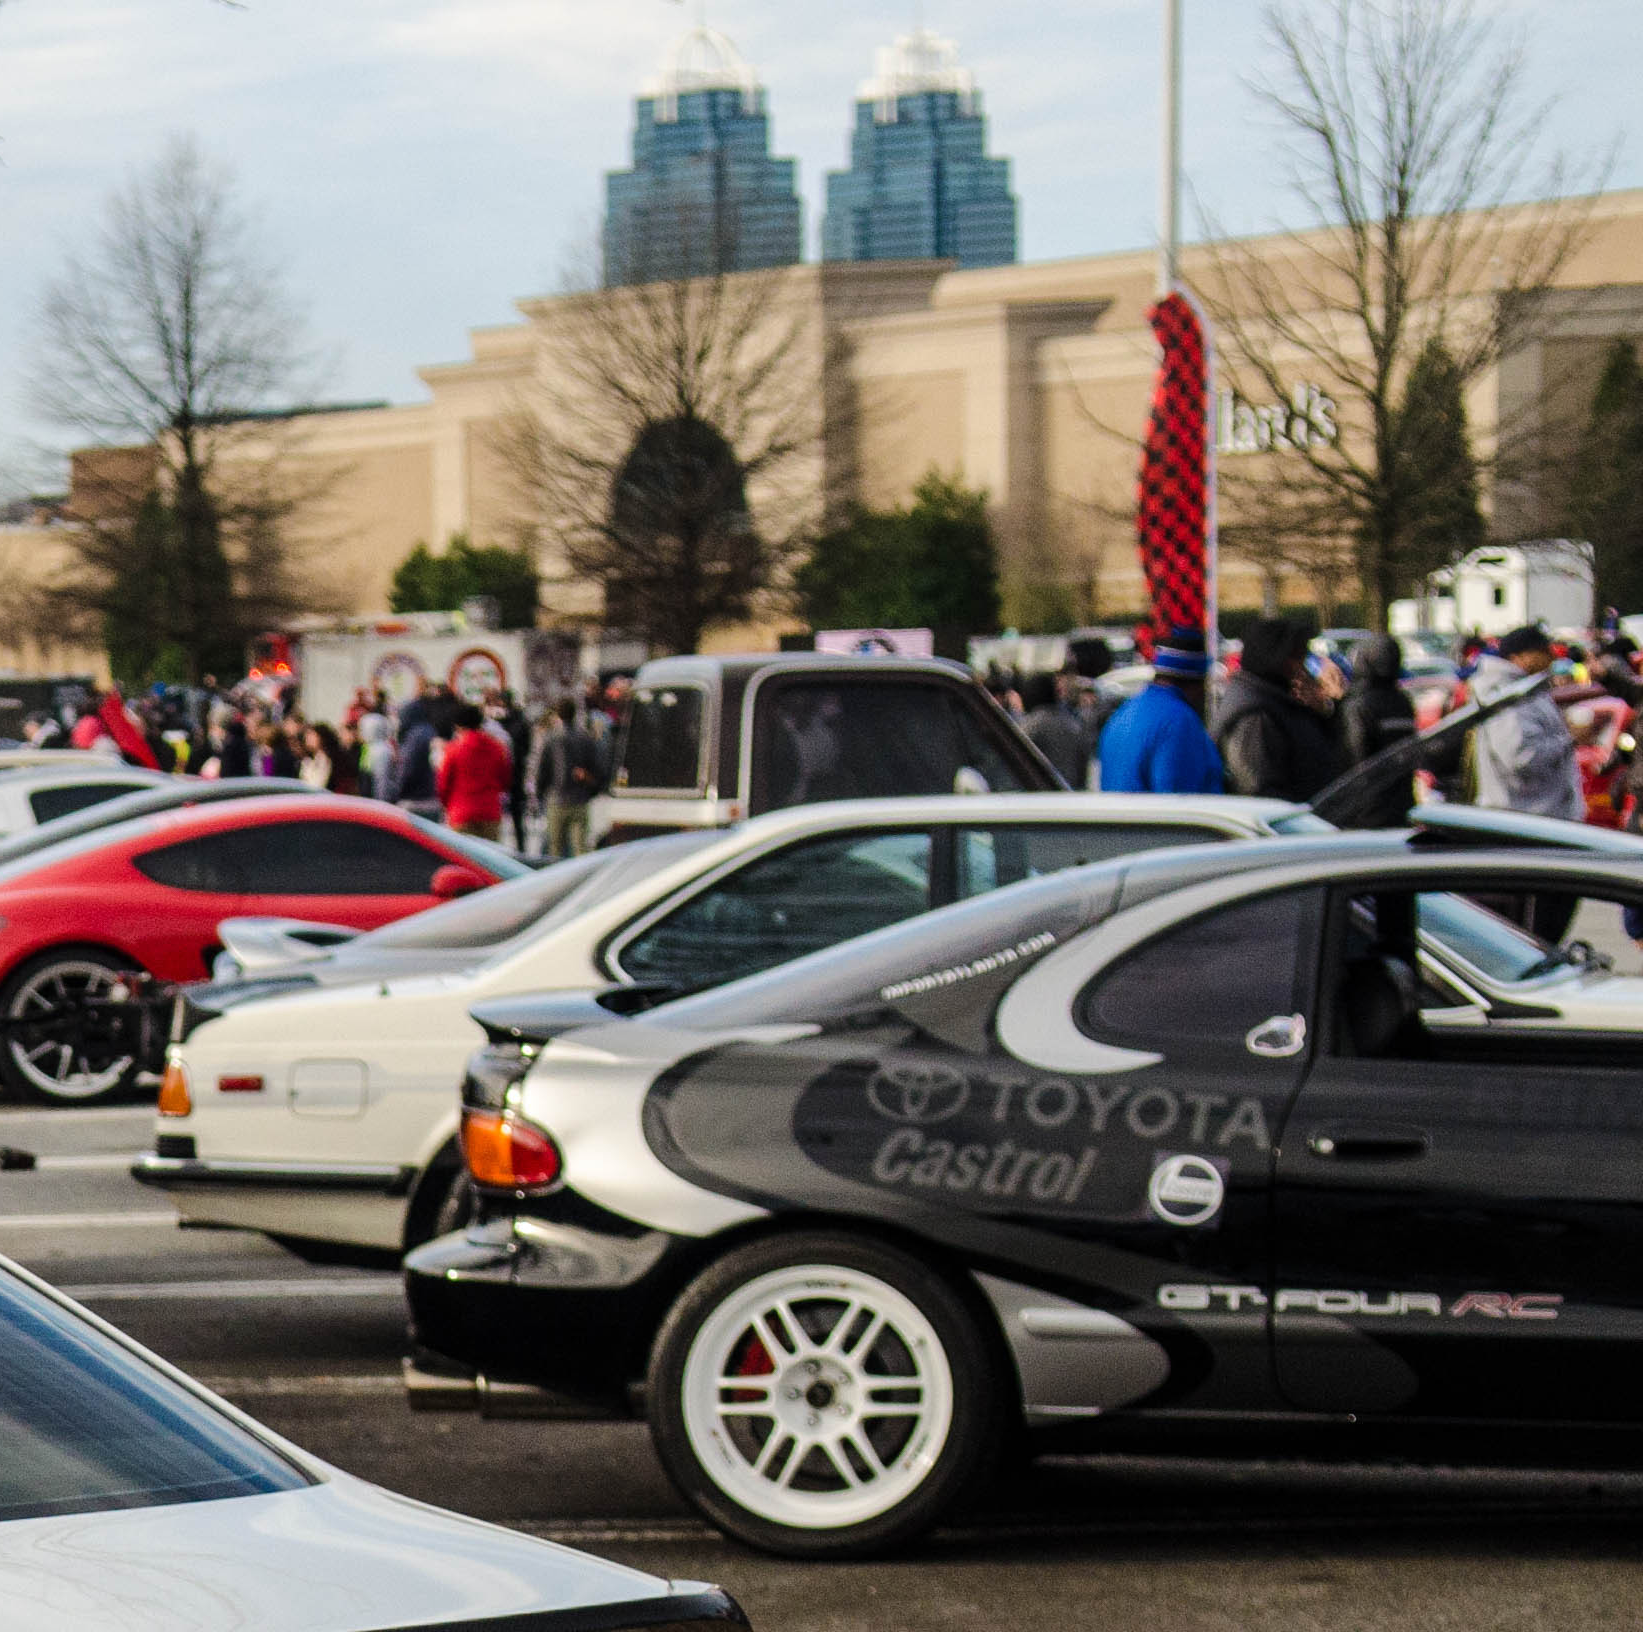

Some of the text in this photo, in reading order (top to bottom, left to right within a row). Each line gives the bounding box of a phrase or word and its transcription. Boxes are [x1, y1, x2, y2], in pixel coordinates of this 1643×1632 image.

[983, 1072, 1272, 1151] TOYOTA
[872, 1128, 1099, 1201] Castrol
[1449, 1291, 1564, 1319] RC
